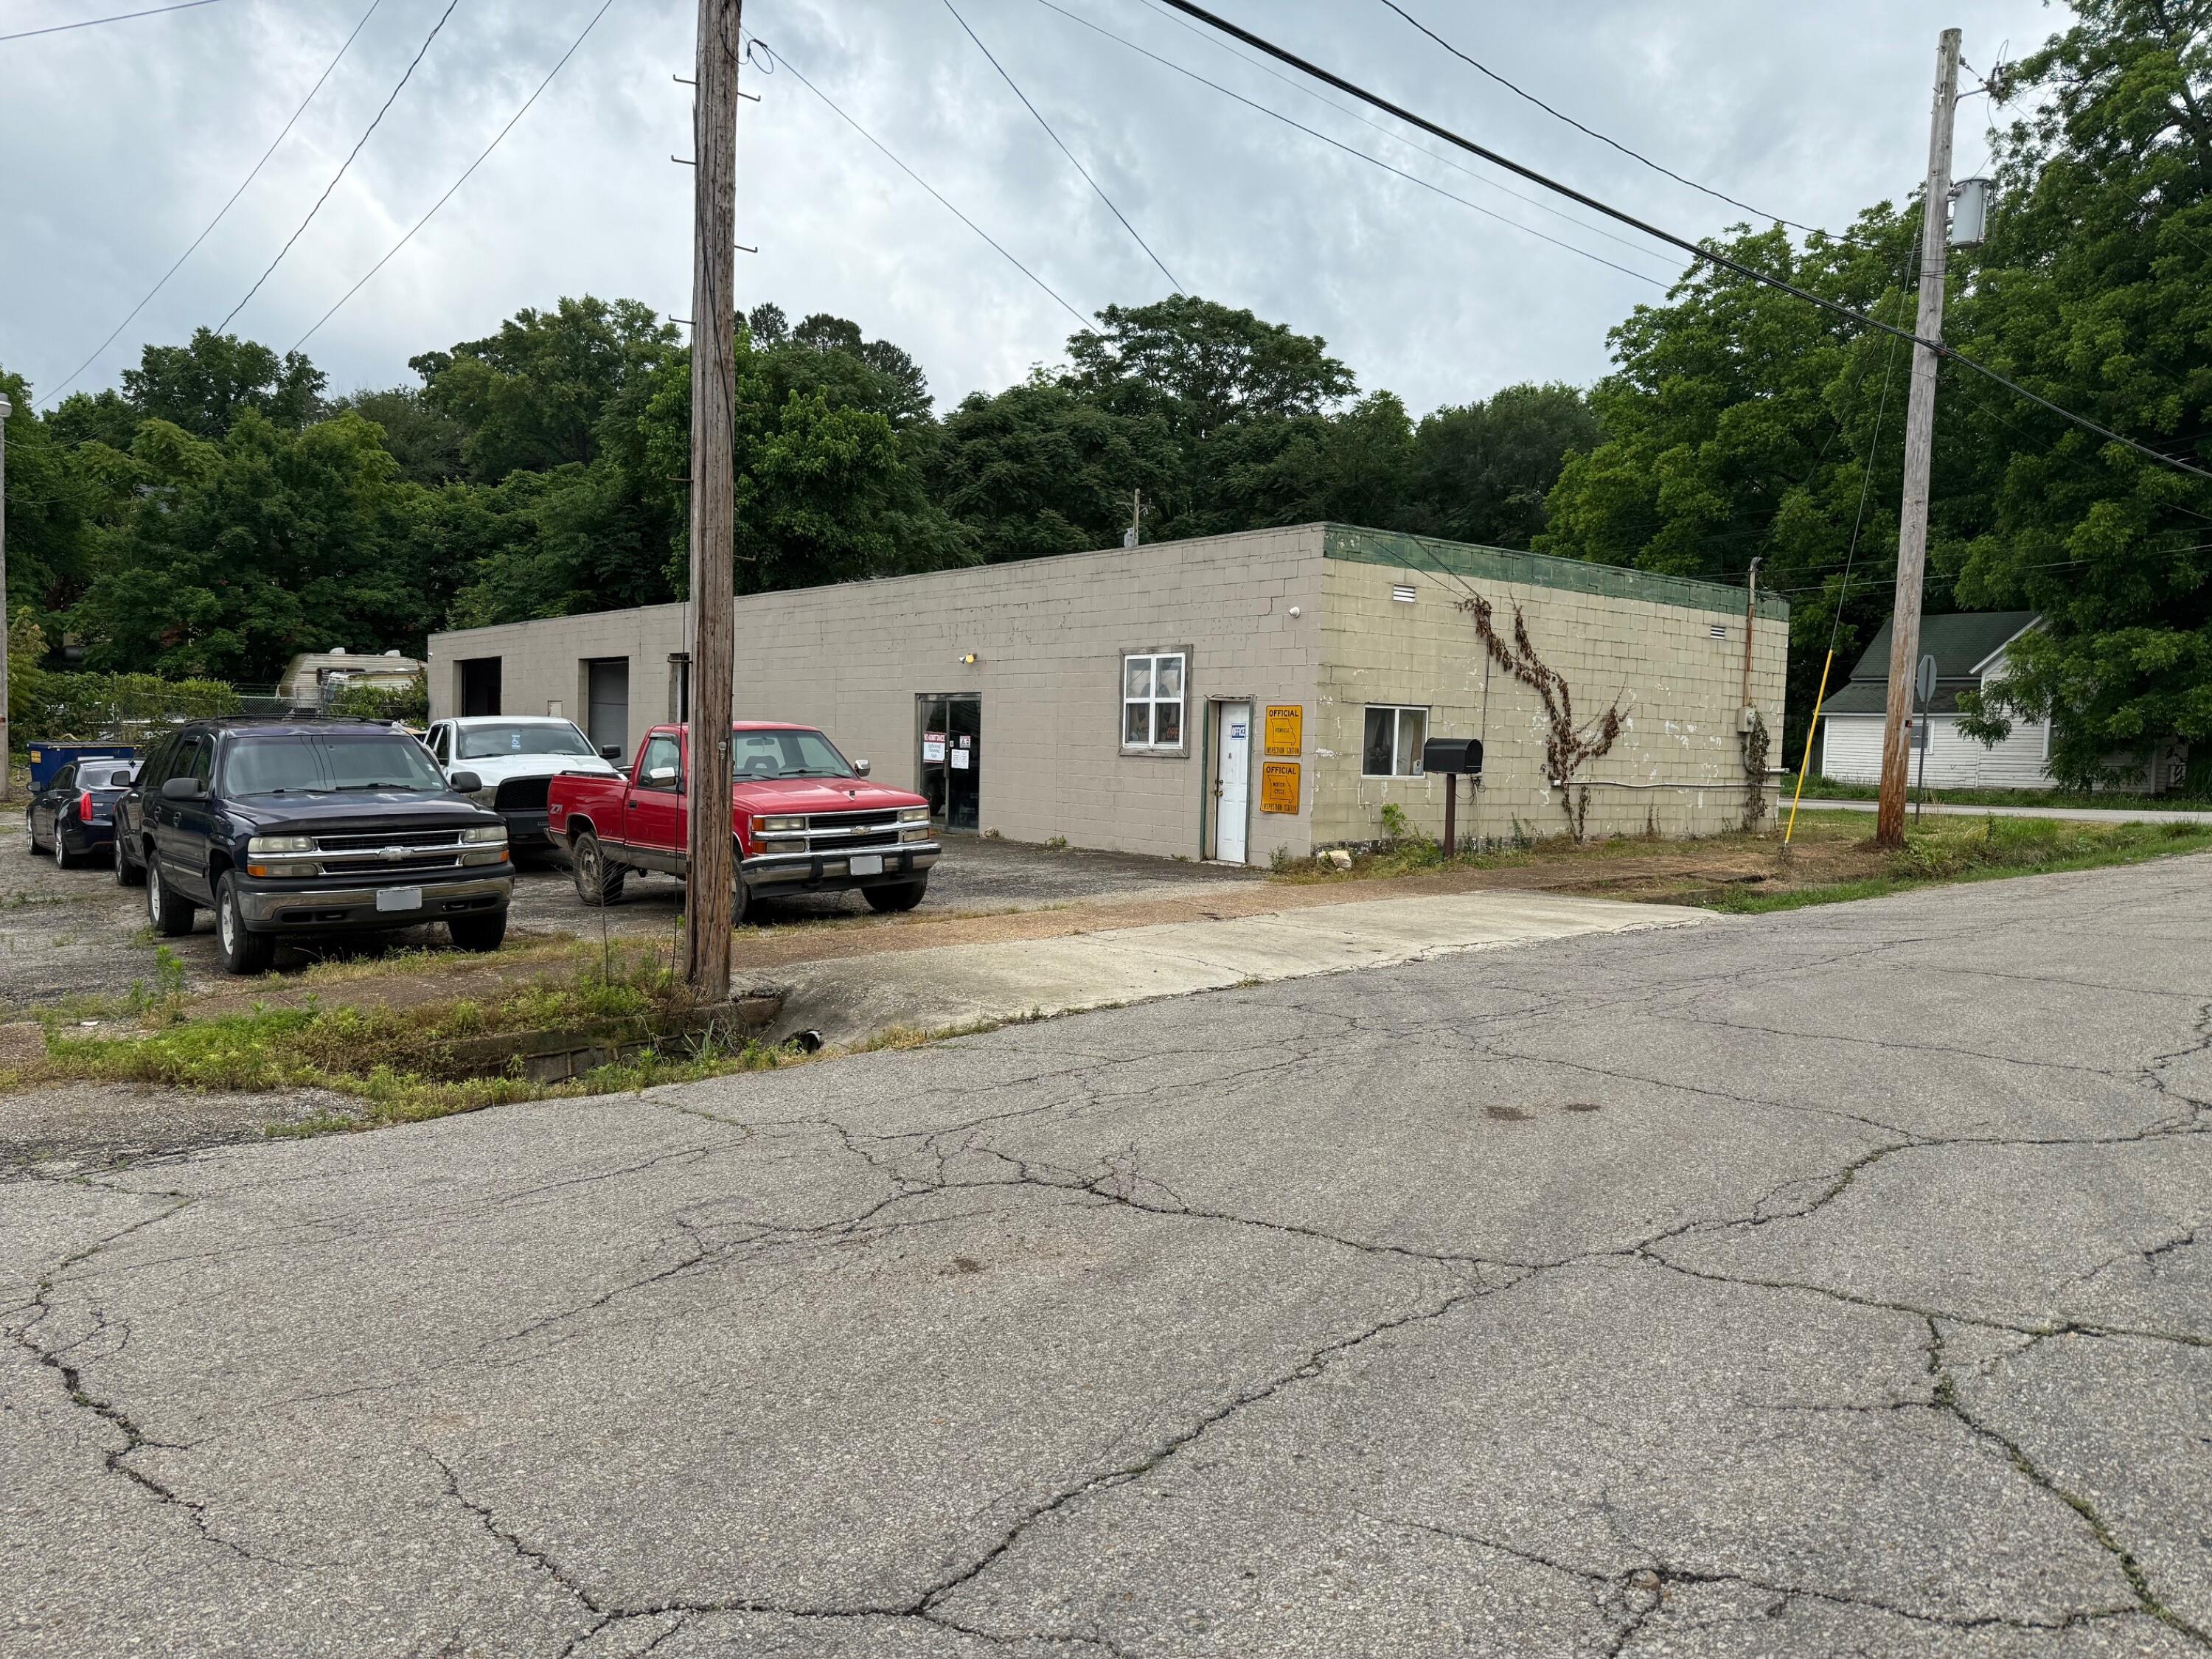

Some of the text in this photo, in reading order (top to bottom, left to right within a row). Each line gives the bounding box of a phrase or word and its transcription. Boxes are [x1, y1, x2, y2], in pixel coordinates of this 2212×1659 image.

[1232, 726, 1245, 736] OFFICE
[1266, 766, 1296, 774] OFFICIAL
[1262, 803, 1281, 811] INSPECTION
